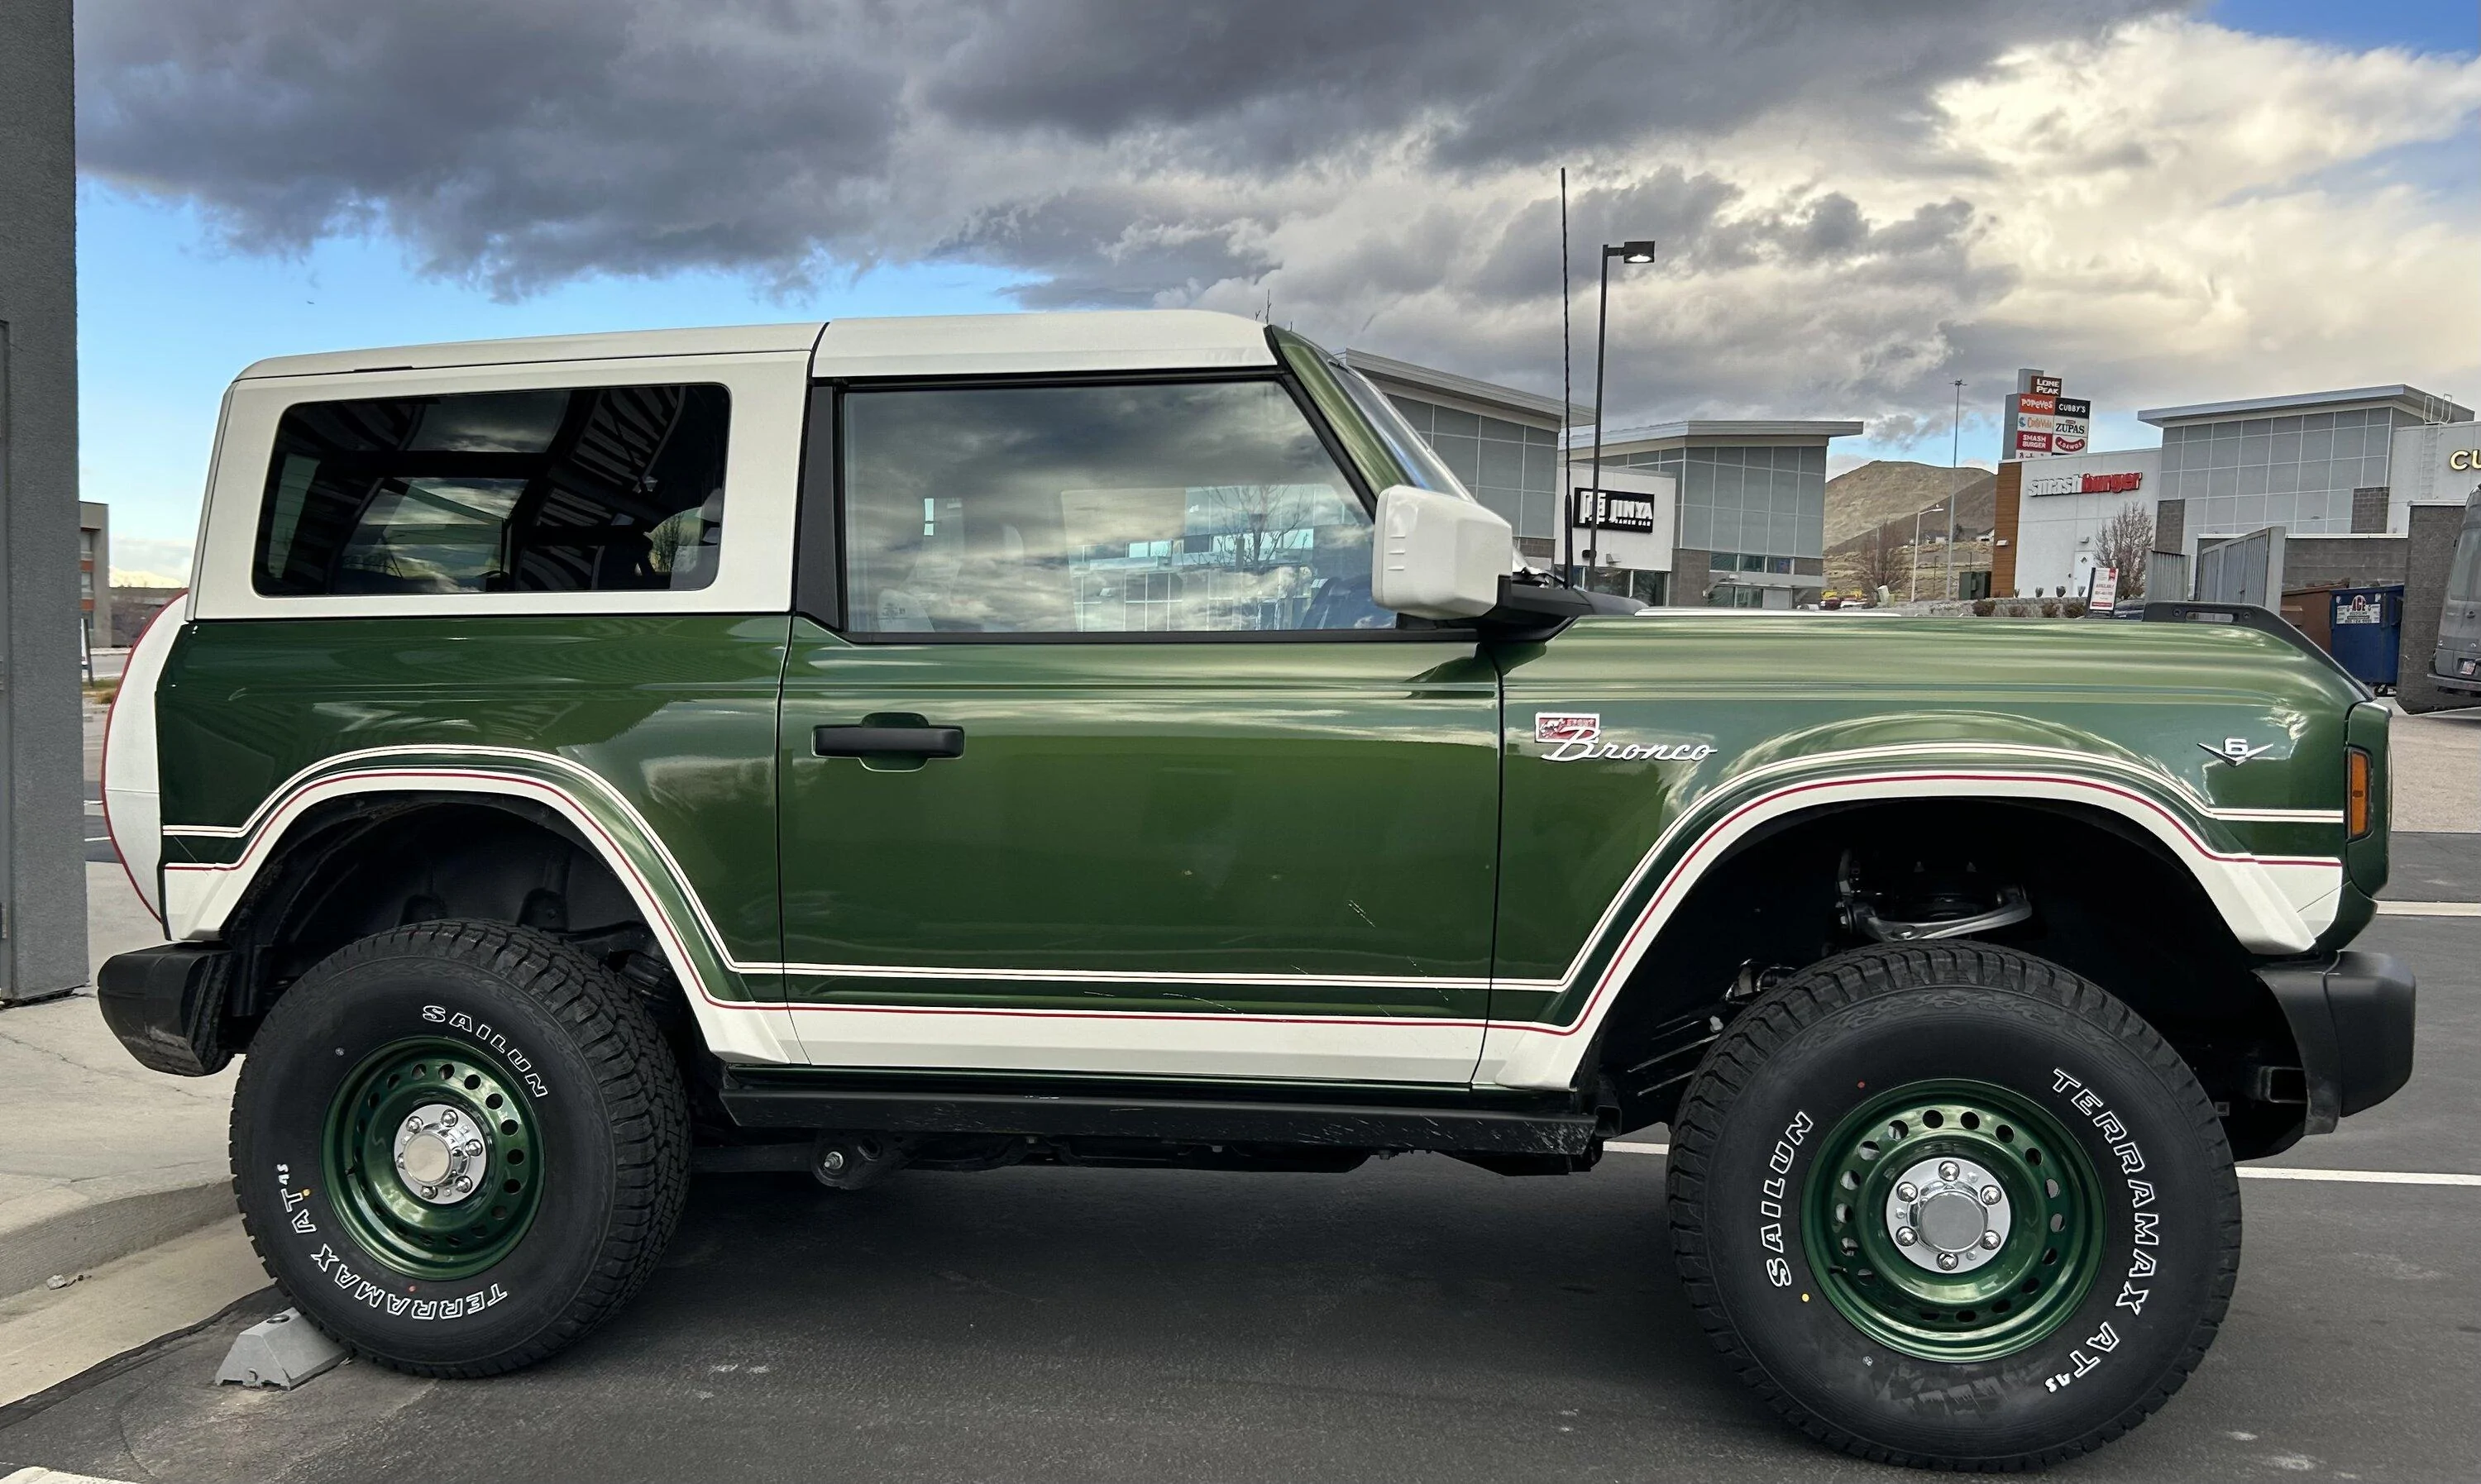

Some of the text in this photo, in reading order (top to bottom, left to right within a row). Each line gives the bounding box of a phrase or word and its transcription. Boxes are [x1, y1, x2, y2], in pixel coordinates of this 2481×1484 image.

[2036, 378, 2059, 388] LONE
[2036, 386, 2058, 394] PEAK
[2058, 403, 2087, 413] CUBBY'S
[2023, 434, 2047, 442] SMASH
[2056, 423, 2085, 434] ZUPAS
[2022, 441, 2046, 449] BURGER
[2028, 472, 2143, 496] smashburger
[1608, 499, 1653, 523] JINYA
[1541, 726, 1719, 761] Bronco
[423, 1005, 548, 1097] SAILUN
[1761, 1110, 1814, 1286] SAILUN
[2053, 1064, 2159, 1316] TERRAMAX
[310, 1243, 509, 1320] TERRAMAX
